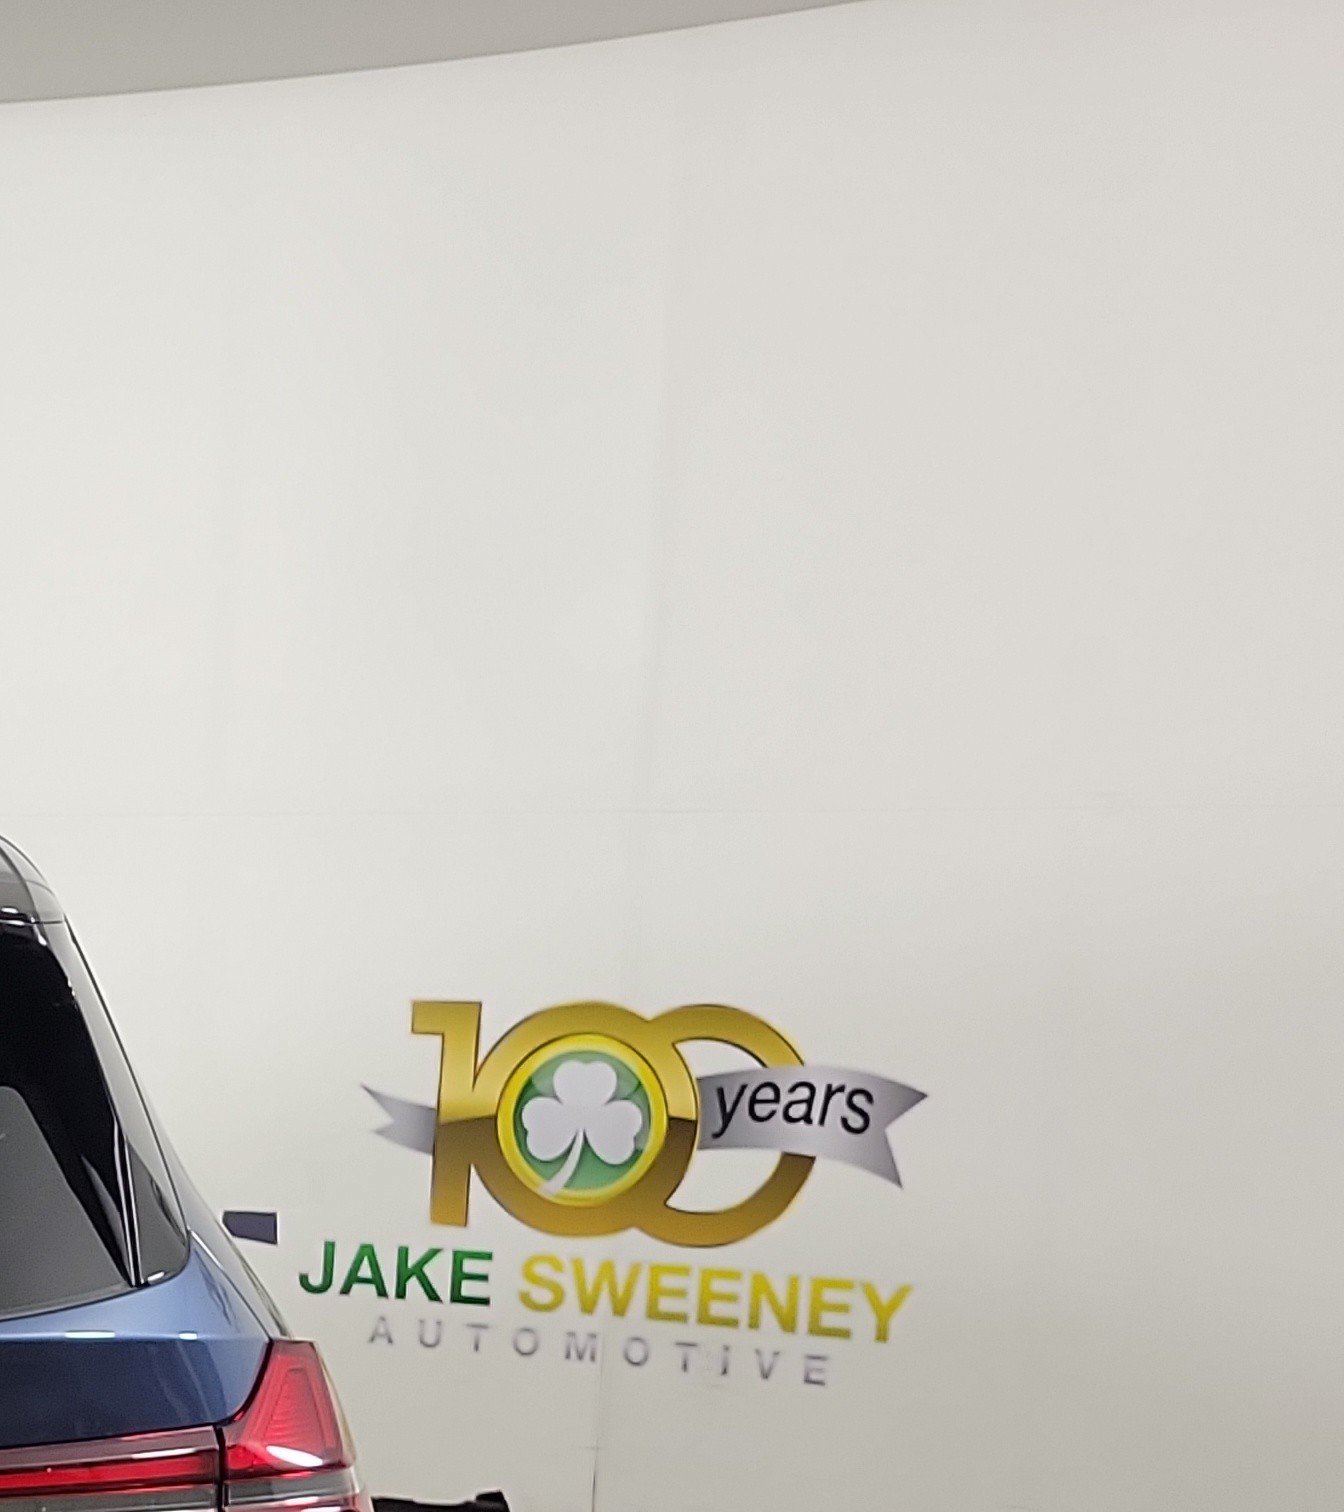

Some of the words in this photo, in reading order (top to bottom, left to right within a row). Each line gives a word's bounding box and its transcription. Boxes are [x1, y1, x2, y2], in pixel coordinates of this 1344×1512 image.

[411, 1000, 815, 1247] 100
[710, 1078, 874, 1138] years
[299, 1240, 493, 1305] JAKE
[517, 1253, 912, 1343] SWEENEY
[368, 1314, 830, 1386] AUTOMOTIVE
